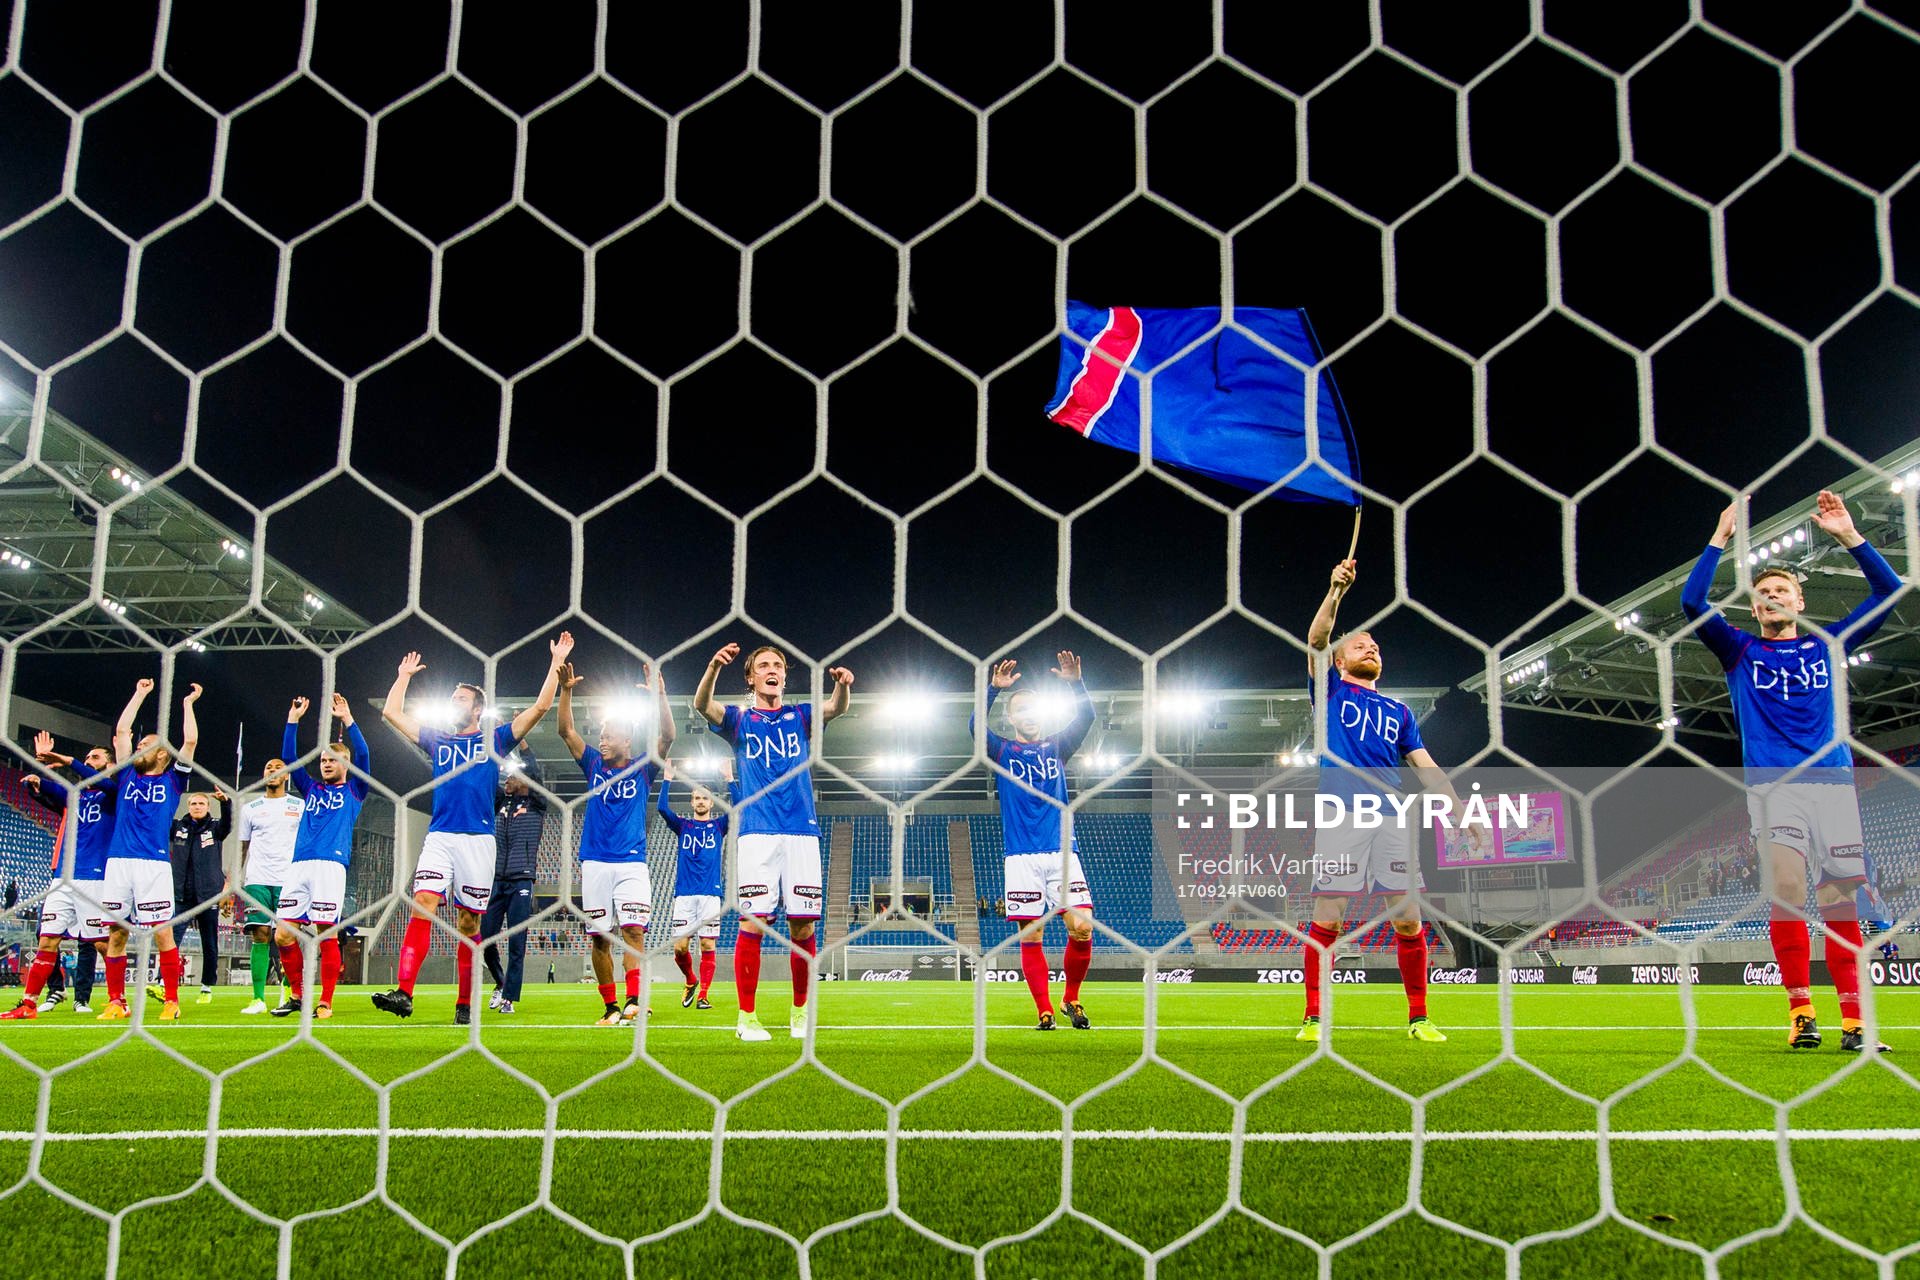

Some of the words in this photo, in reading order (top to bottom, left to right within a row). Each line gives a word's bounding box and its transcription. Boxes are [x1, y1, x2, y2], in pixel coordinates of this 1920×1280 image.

[1753, 657, 1829, 701] DNB
[1341, 700, 1400, 744] DNB
[438, 738, 489, 772] DNB
[745, 727, 801, 768] DNB
[1009, 754, 1060, 788] DNB
[593, 773, 638, 805] DNB
[75, 801, 102, 823] NB
[306, 793, 345, 816] DNB
[682, 830, 717, 855] DNB
[1833, 846, 1864, 856] HOUSE
[804, 901, 813, 909] 18
[974, 970, 1019, 982] ero
[1257, 969, 1304, 983] zero
[1330, 970, 1366, 983] GAR
[1430, 968, 1477, 984] Coca-Cola
[1519, 969, 1545, 983] SUGAR
[1632, 966, 1660, 984] zero
